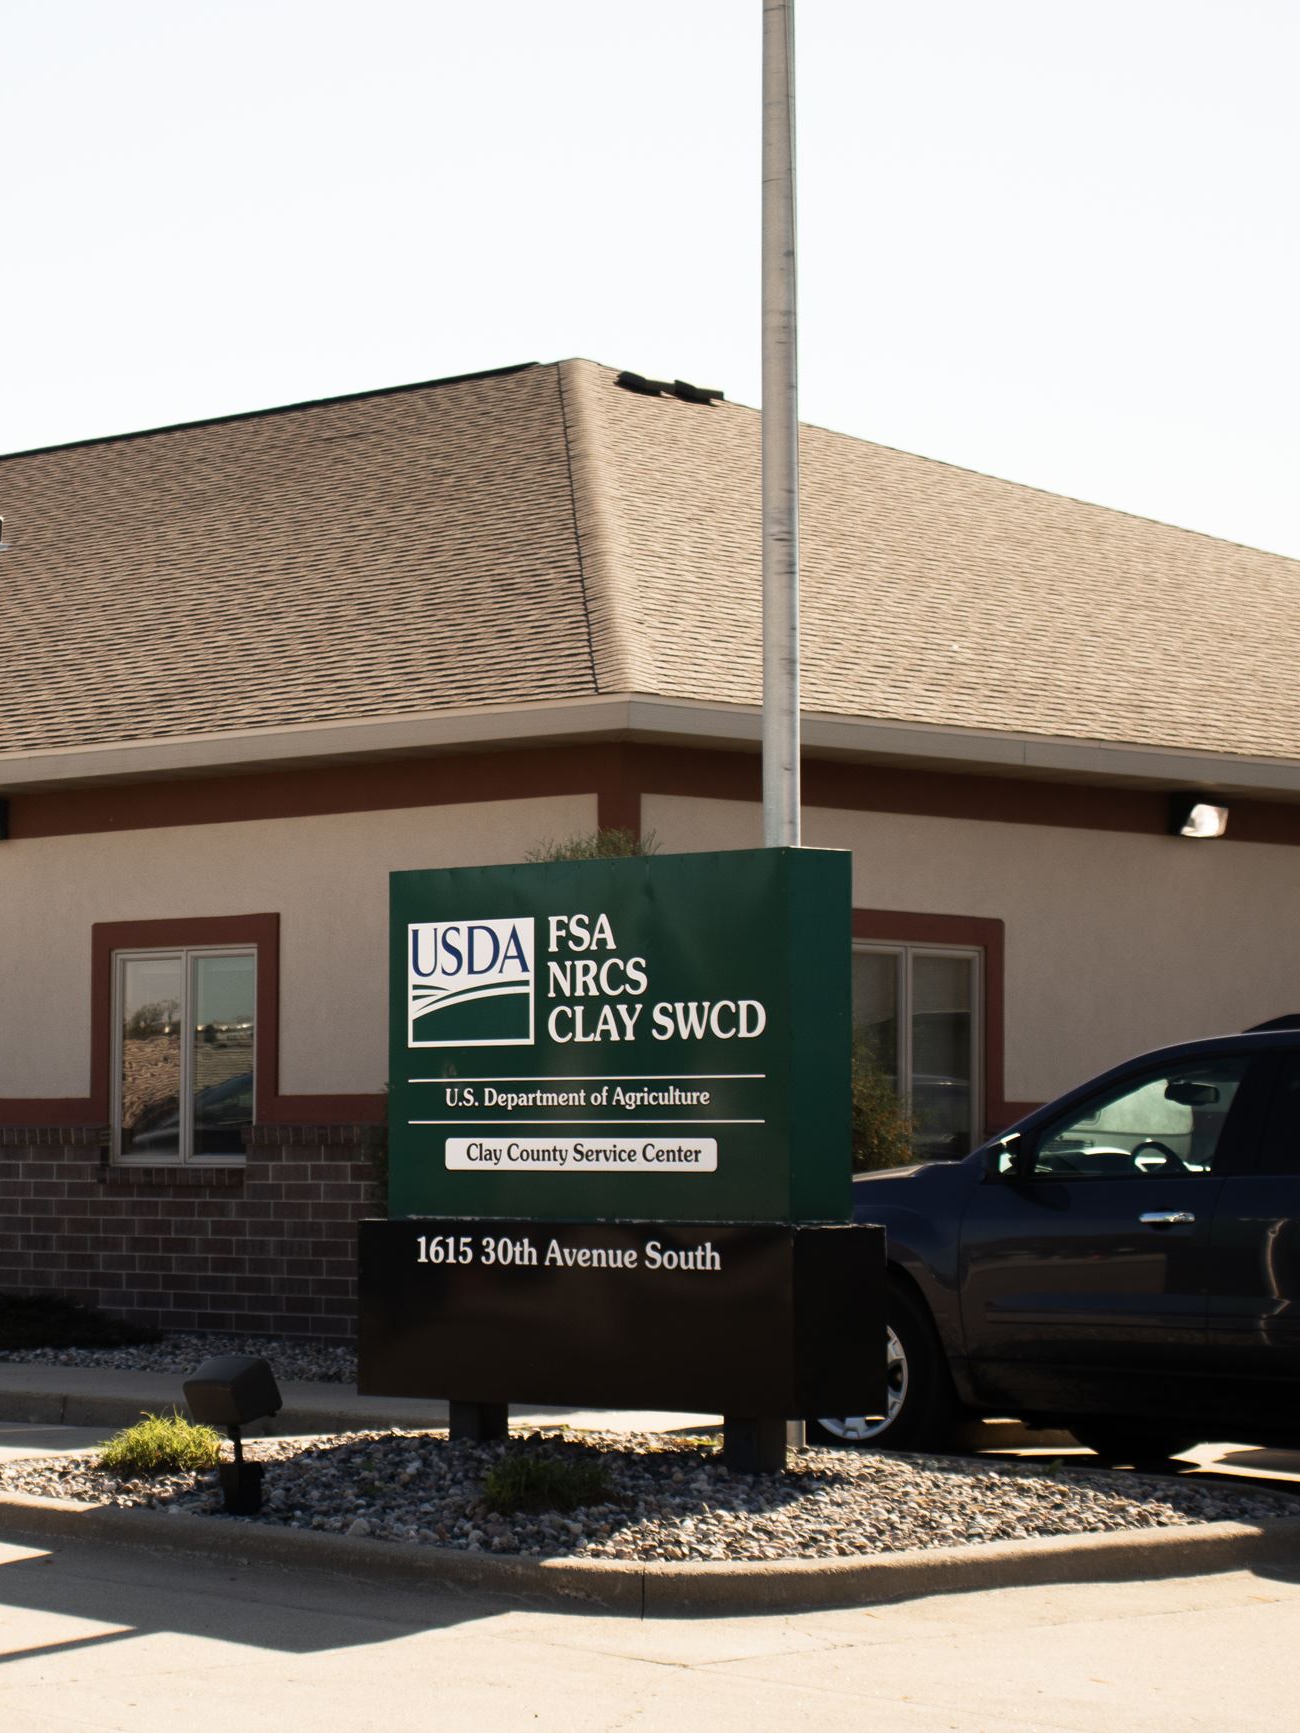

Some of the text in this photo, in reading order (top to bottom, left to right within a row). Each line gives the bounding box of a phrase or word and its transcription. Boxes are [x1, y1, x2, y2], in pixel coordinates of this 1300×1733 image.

[411, 924, 530, 977] USDA
[548, 914, 616, 952] FSA
[548, 957, 648, 997] NRCS
[548, 1000, 766, 1043] CLAY SWCD
[445, 1086, 710, 1110] U.S. Department of Agriculture
[466, 1143, 702, 1166] Clay County Service Center
[417, 1236, 722, 1271] 1615 30th Avenue South
